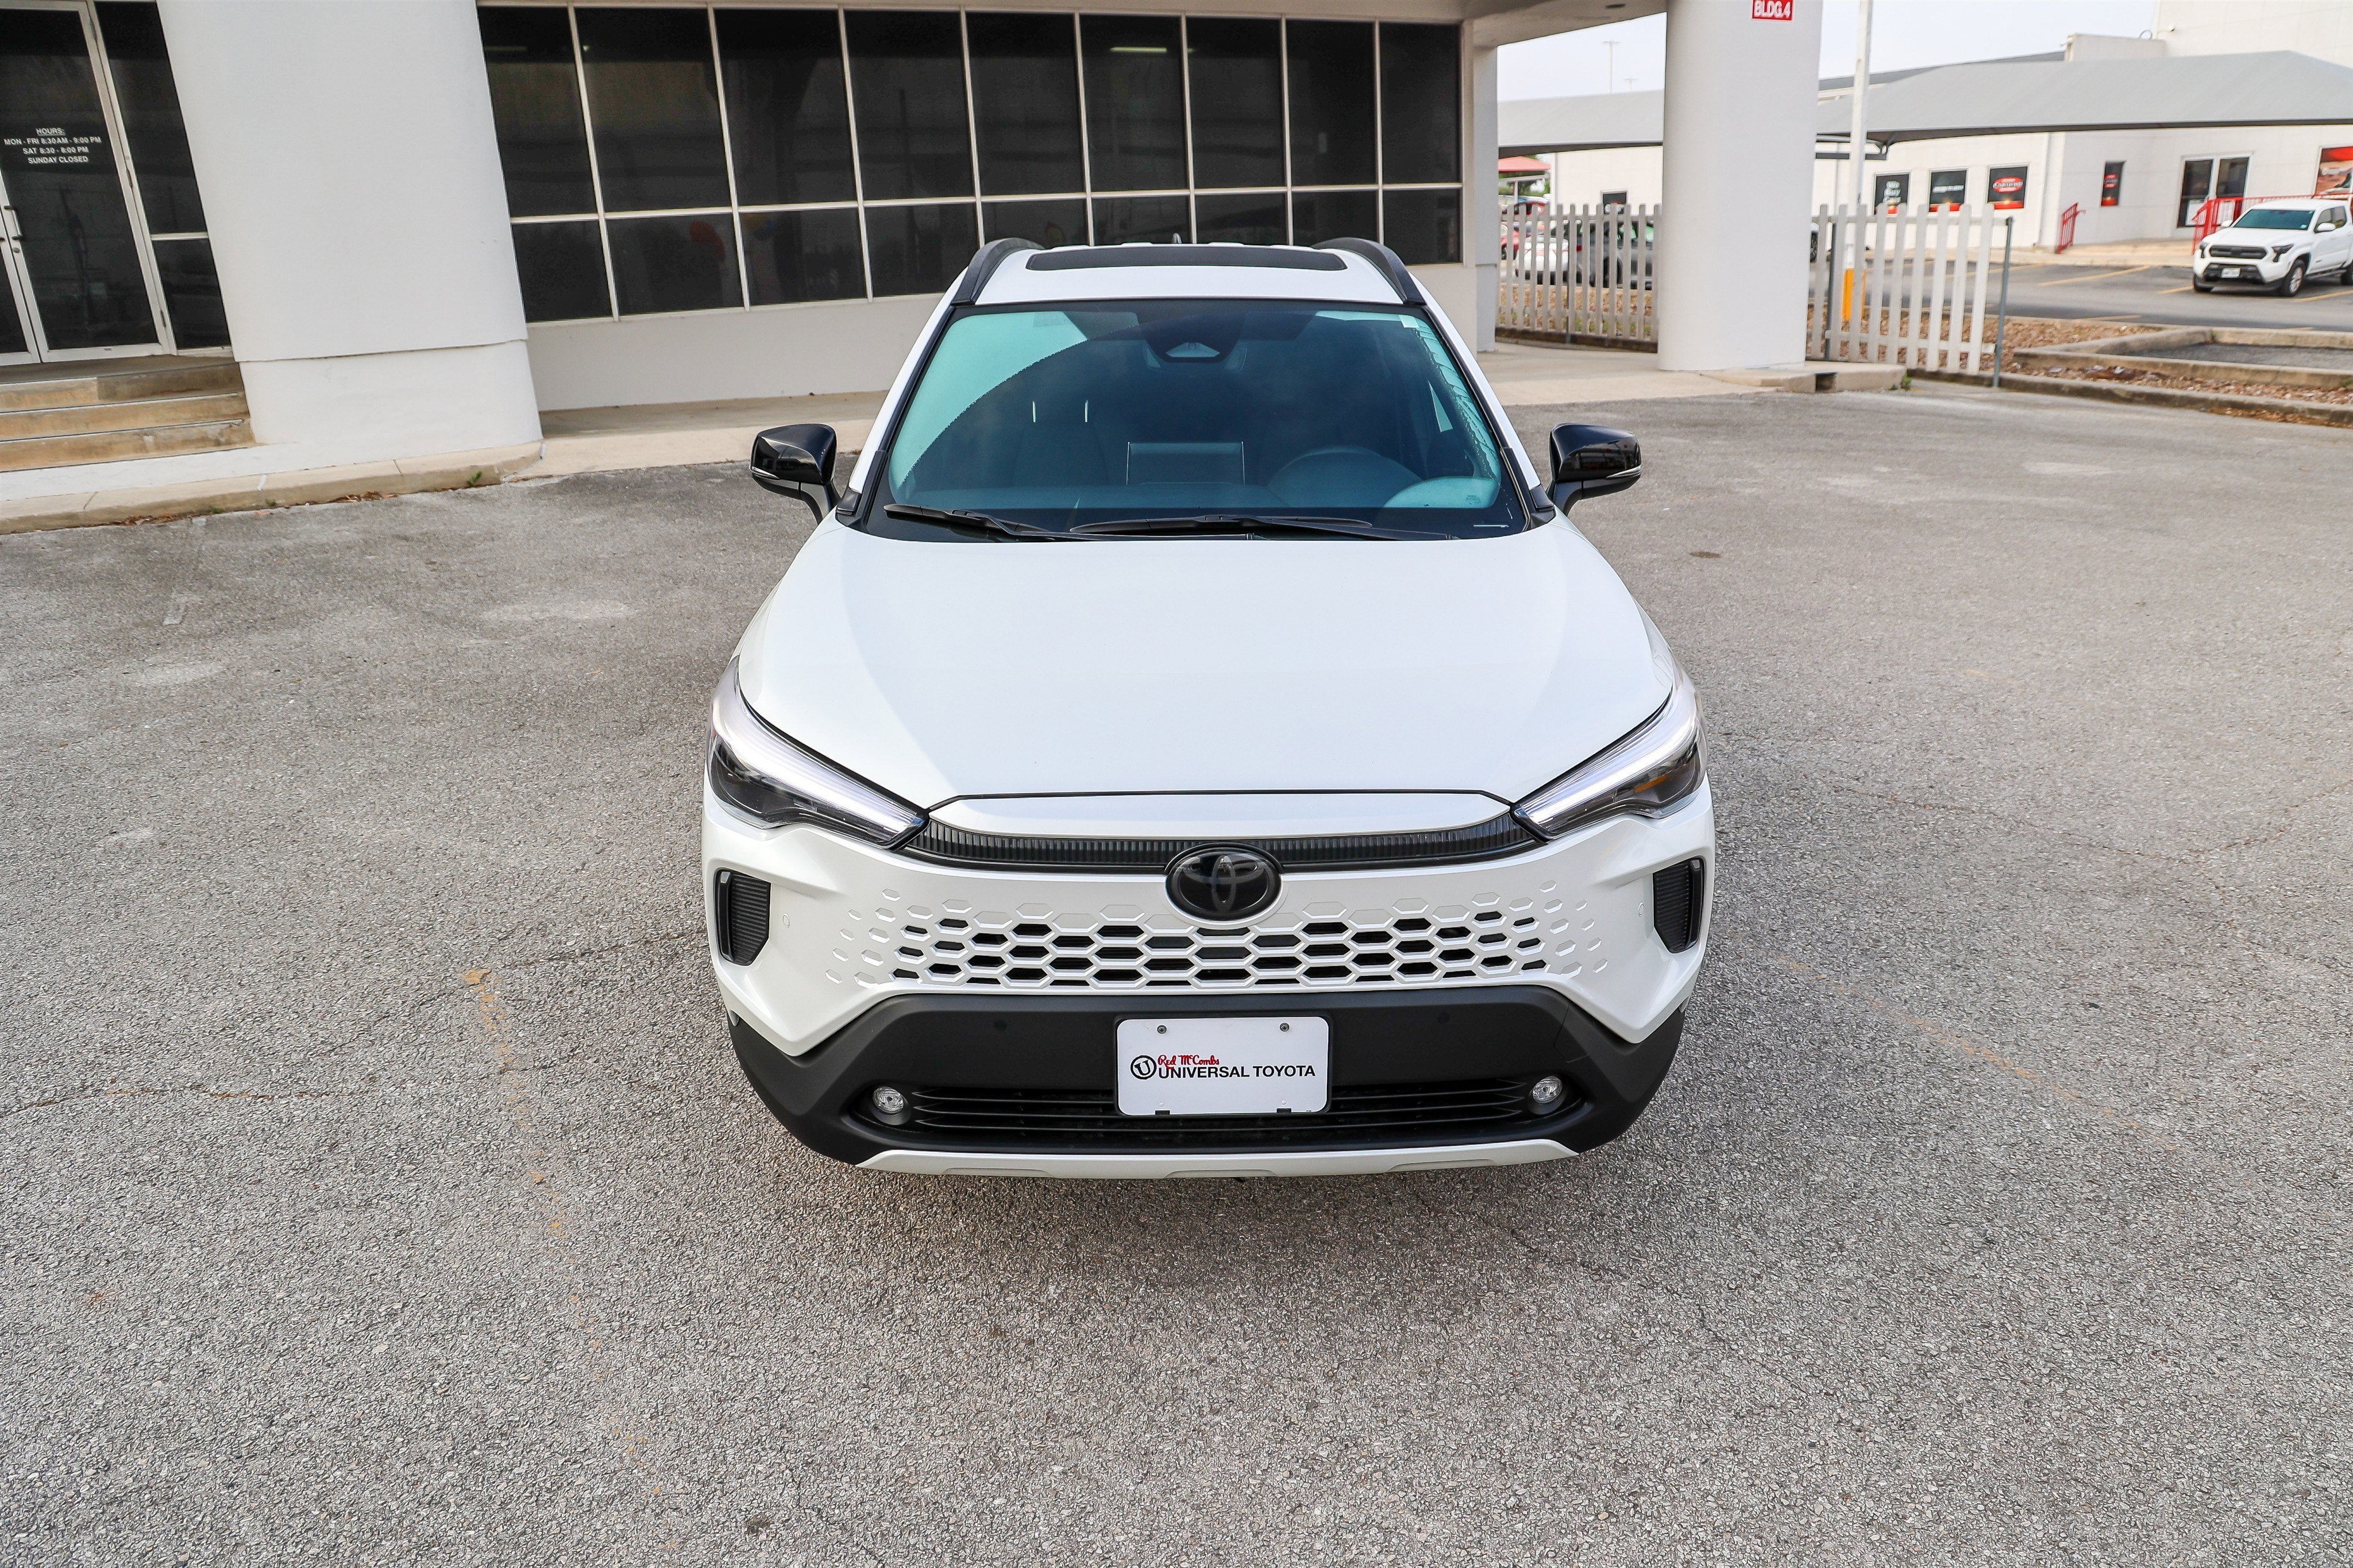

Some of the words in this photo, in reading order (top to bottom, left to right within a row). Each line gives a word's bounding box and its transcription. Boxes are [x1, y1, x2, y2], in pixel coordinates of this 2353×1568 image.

[1784, 1, 1791, 18] 4
[36, 128, 65, 136] HOURS:
[1157, 1055, 1176, 1069] Red
[1178, 1055, 1220, 1065] McCombs
[1158, 1066, 1249, 1079] UNIVERSAL
[1255, 1065, 1316, 1077] TOYOTA
